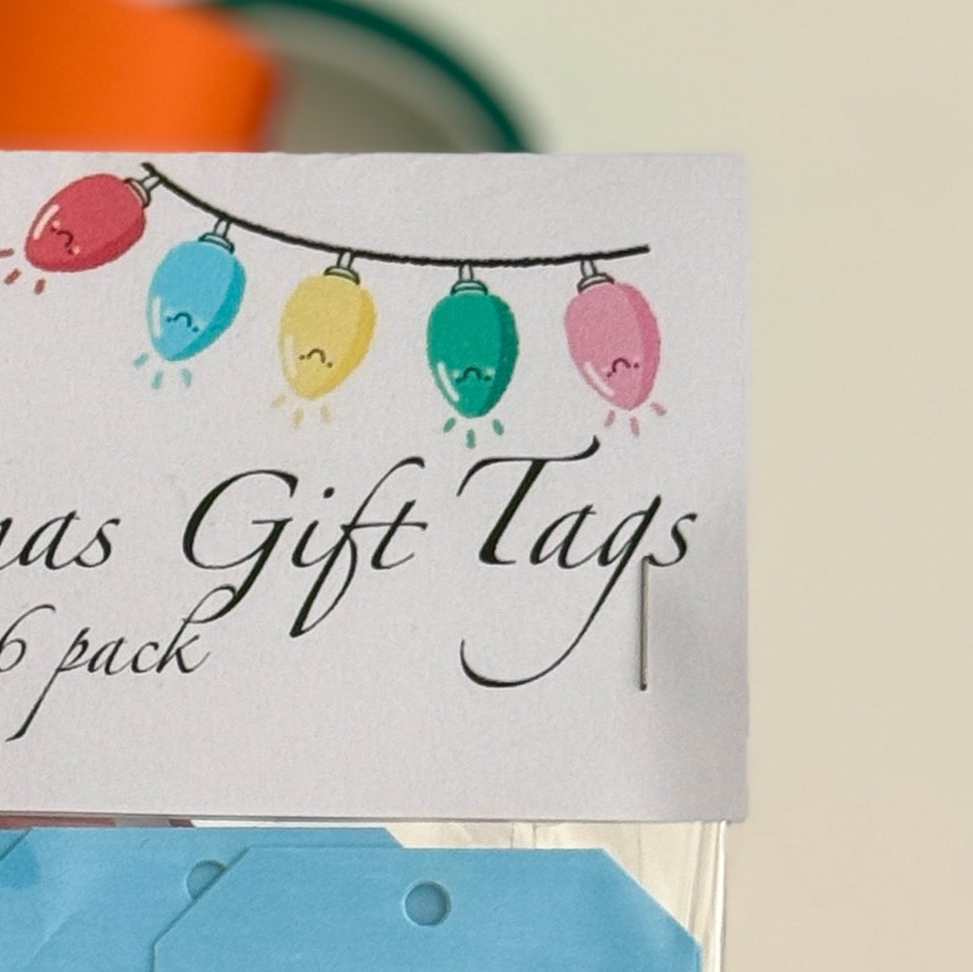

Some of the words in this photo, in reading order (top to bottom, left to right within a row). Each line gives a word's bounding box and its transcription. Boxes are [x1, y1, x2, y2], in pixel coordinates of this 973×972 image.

[4, 585, 212, 743] pack
[181, 456, 429, 639] Gift
[455, 435, 698, 688] Tags
